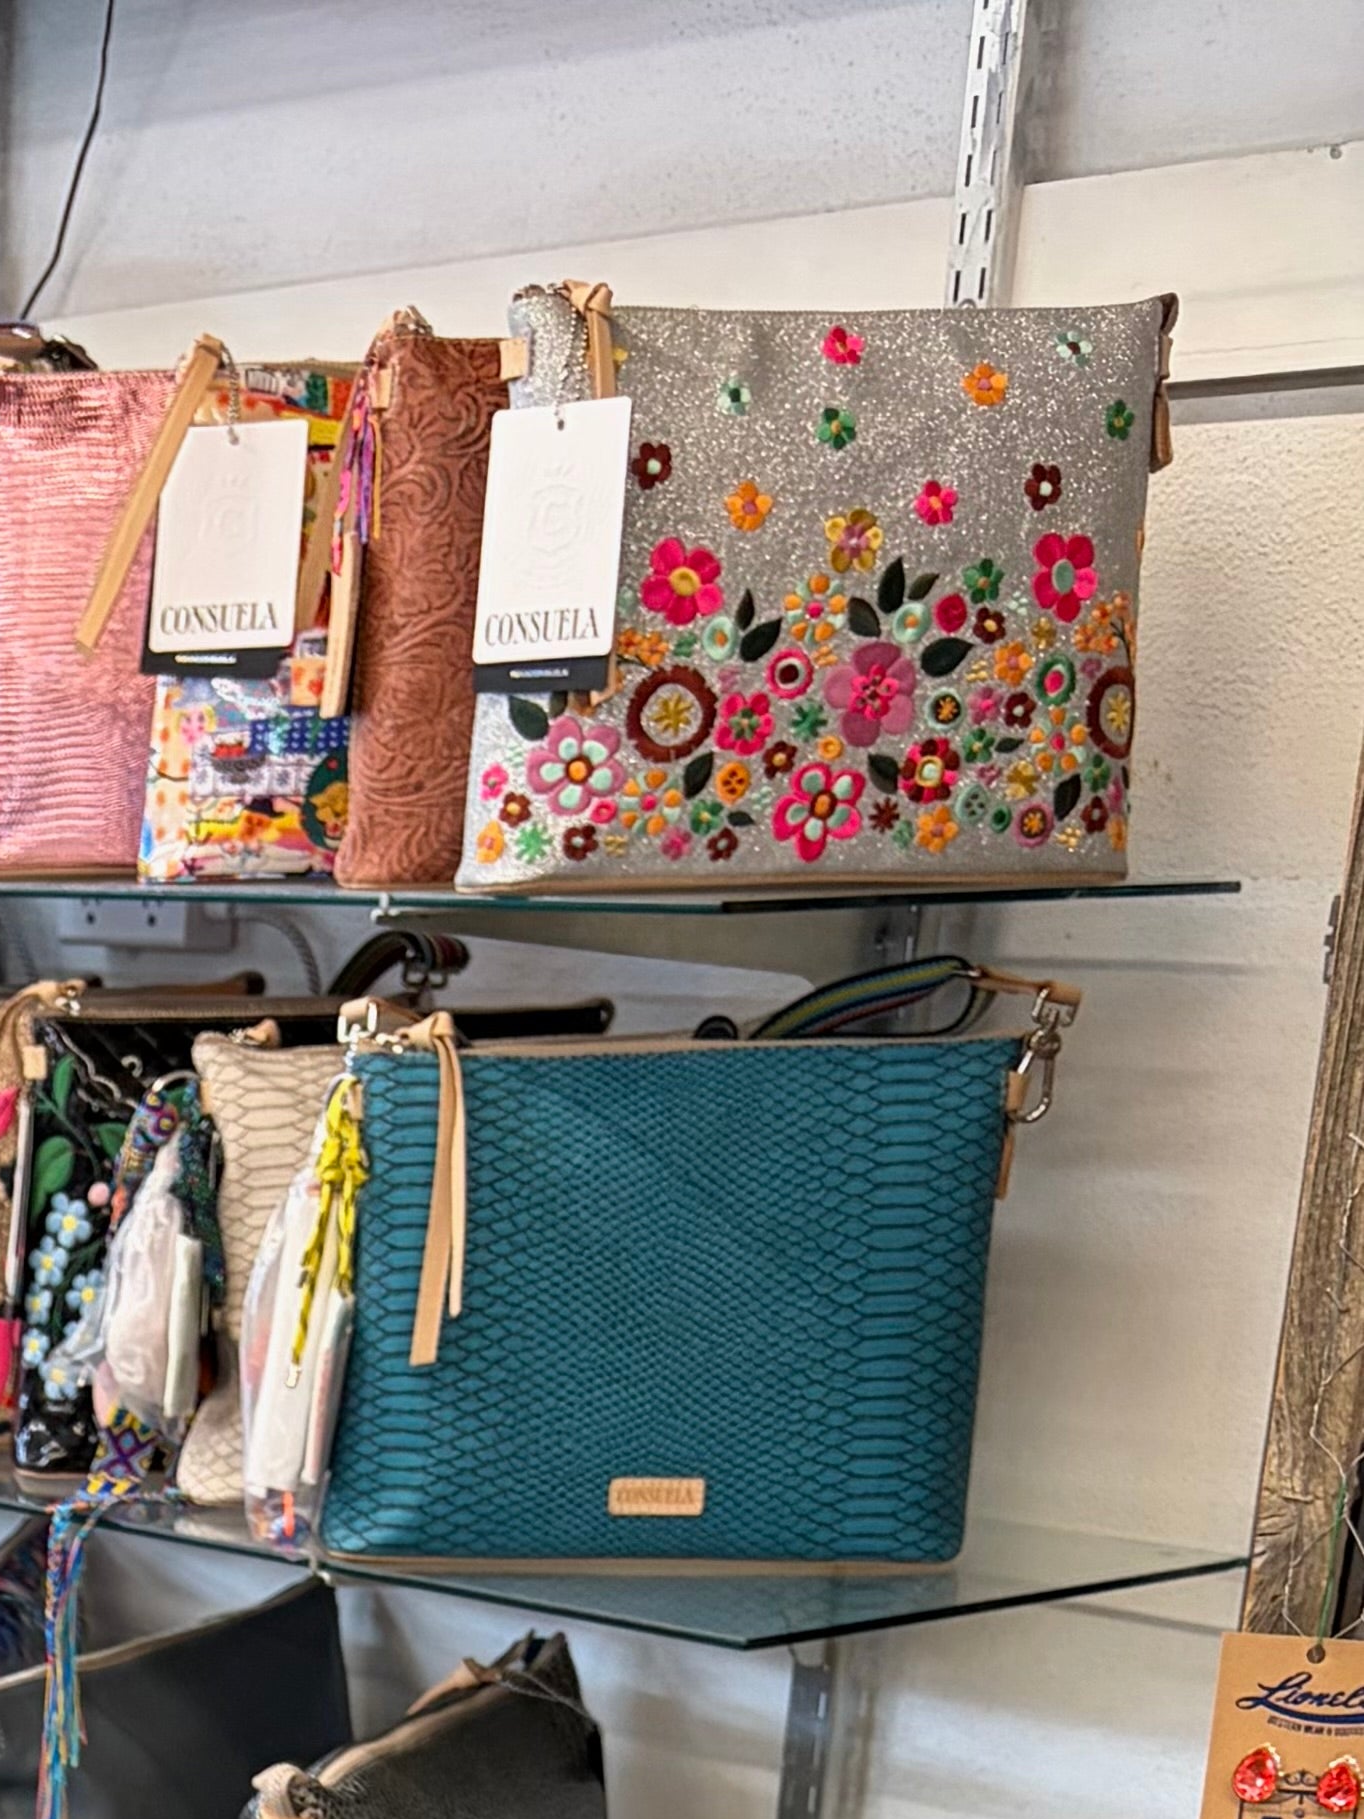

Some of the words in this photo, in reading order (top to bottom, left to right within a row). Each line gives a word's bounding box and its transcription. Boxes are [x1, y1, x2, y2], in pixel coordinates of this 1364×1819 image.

[160, 602, 277, 635] CONSUELA
[485, 607, 600, 647] CONSUELA
[615, 1485, 695, 1505] CONSUELA
[1235, 1671, 1364, 1711] Lionel
